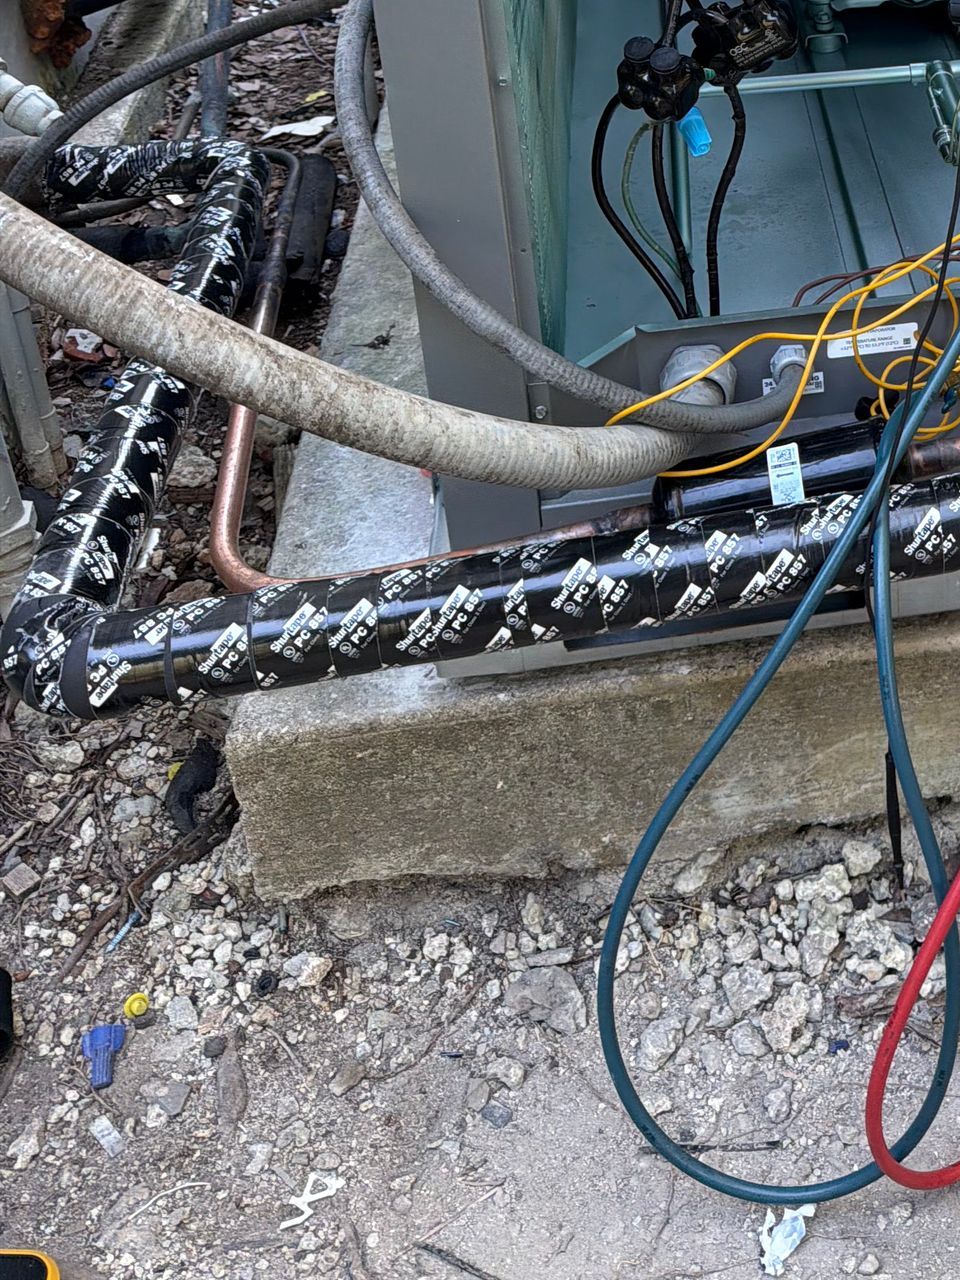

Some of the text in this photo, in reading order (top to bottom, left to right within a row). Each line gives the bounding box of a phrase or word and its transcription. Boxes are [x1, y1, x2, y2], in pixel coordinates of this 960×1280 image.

[63, 521, 82, 534] 857
[837, 509, 852, 525] PC
[903, 516, 934, 557] Shurtape
[924, 534, 941, 552] PC
[654, 544, 673, 567] 857
[709, 533, 740, 573] PC 857
[425, 564, 441, 579] PC
[789, 553, 807, 575] 857
[90, 567, 107, 585] 857
[386, 569, 423, 600] PC 857
[261, 588, 278, 604] PC
[550, 565, 583, 610] Shurtape
[573, 584, 590, 603] PC
[610, 579, 629, 603] 857
[697, 586, 715, 606] 857
[186, 607, 204, 621] PC
[452, 587, 484, 630] PC 857
[132, 607, 175, 639] PC 857
[270, 610, 307, 654] Shurtape
[294, 606, 329, 648] PC 857
[395, 611, 432, 652] Shurtape
[542, 626, 560, 641] 857
[351, 626, 368, 645] PC
[3, 654, 18, 669] 857
[36, 639, 72, 675] PC 857
[197, 629, 235, 675] Shurtape
[222, 651, 239, 669] PC
[90, 664, 108, 683] PC
[95, 660, 132, 700] Shurtape
[260, 672, 280, 688] 857
